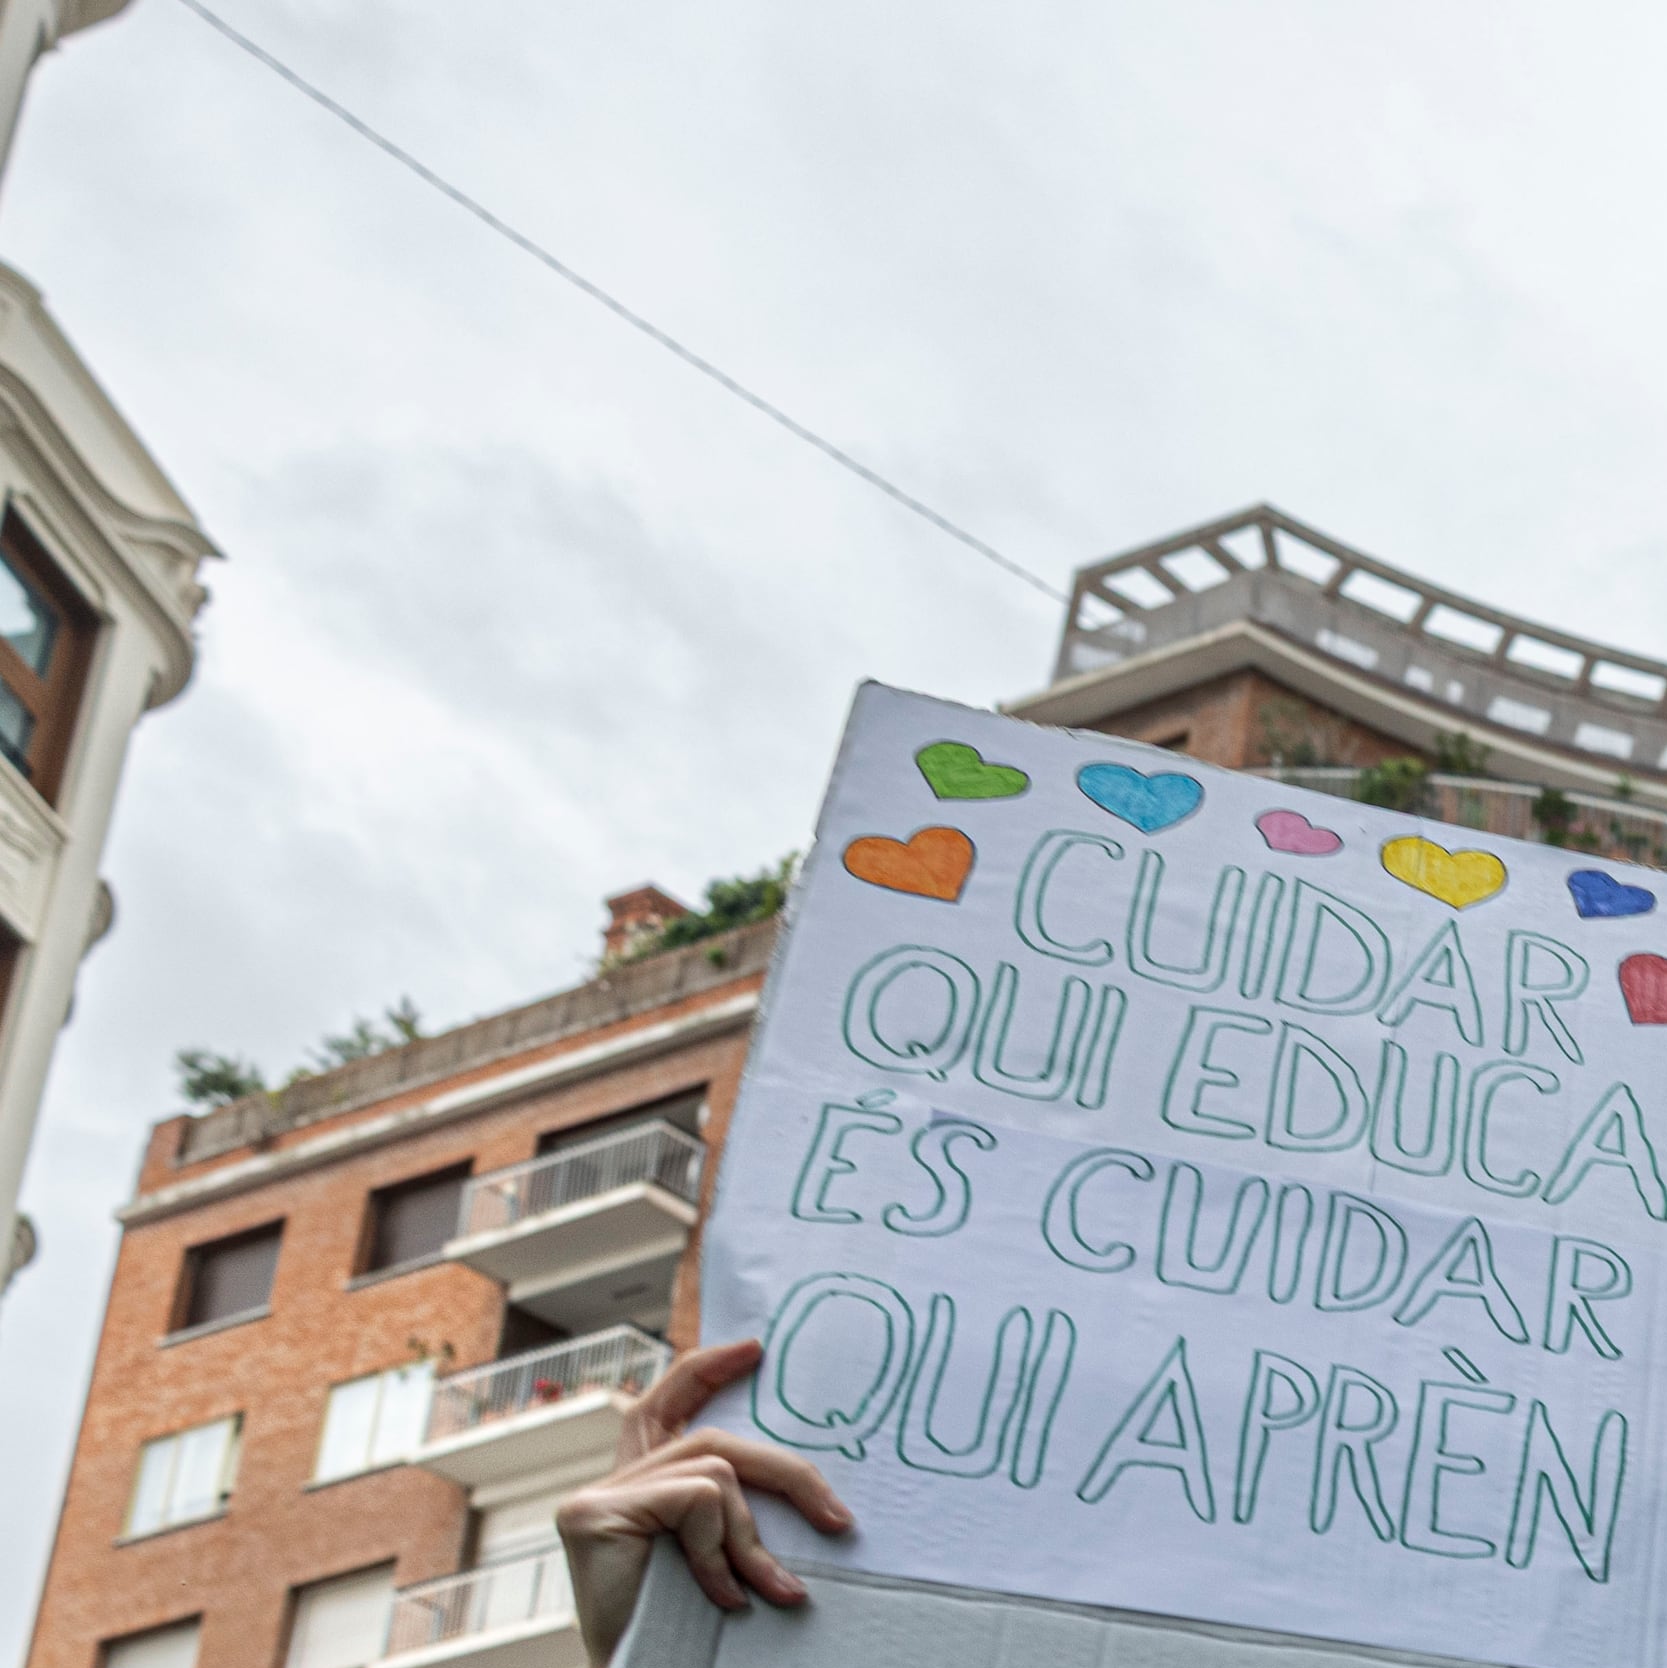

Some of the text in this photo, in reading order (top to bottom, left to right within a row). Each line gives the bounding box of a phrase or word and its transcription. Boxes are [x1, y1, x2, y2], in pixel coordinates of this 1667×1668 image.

[841, 943, 1127, 1110] QUI
[1013, 829, 1590, 1064] CUIDAR
[790, 1088, 1634, 1360] ÉS CUIDAR
[751, 1270, 1628, 1584] QUI APRÈN
